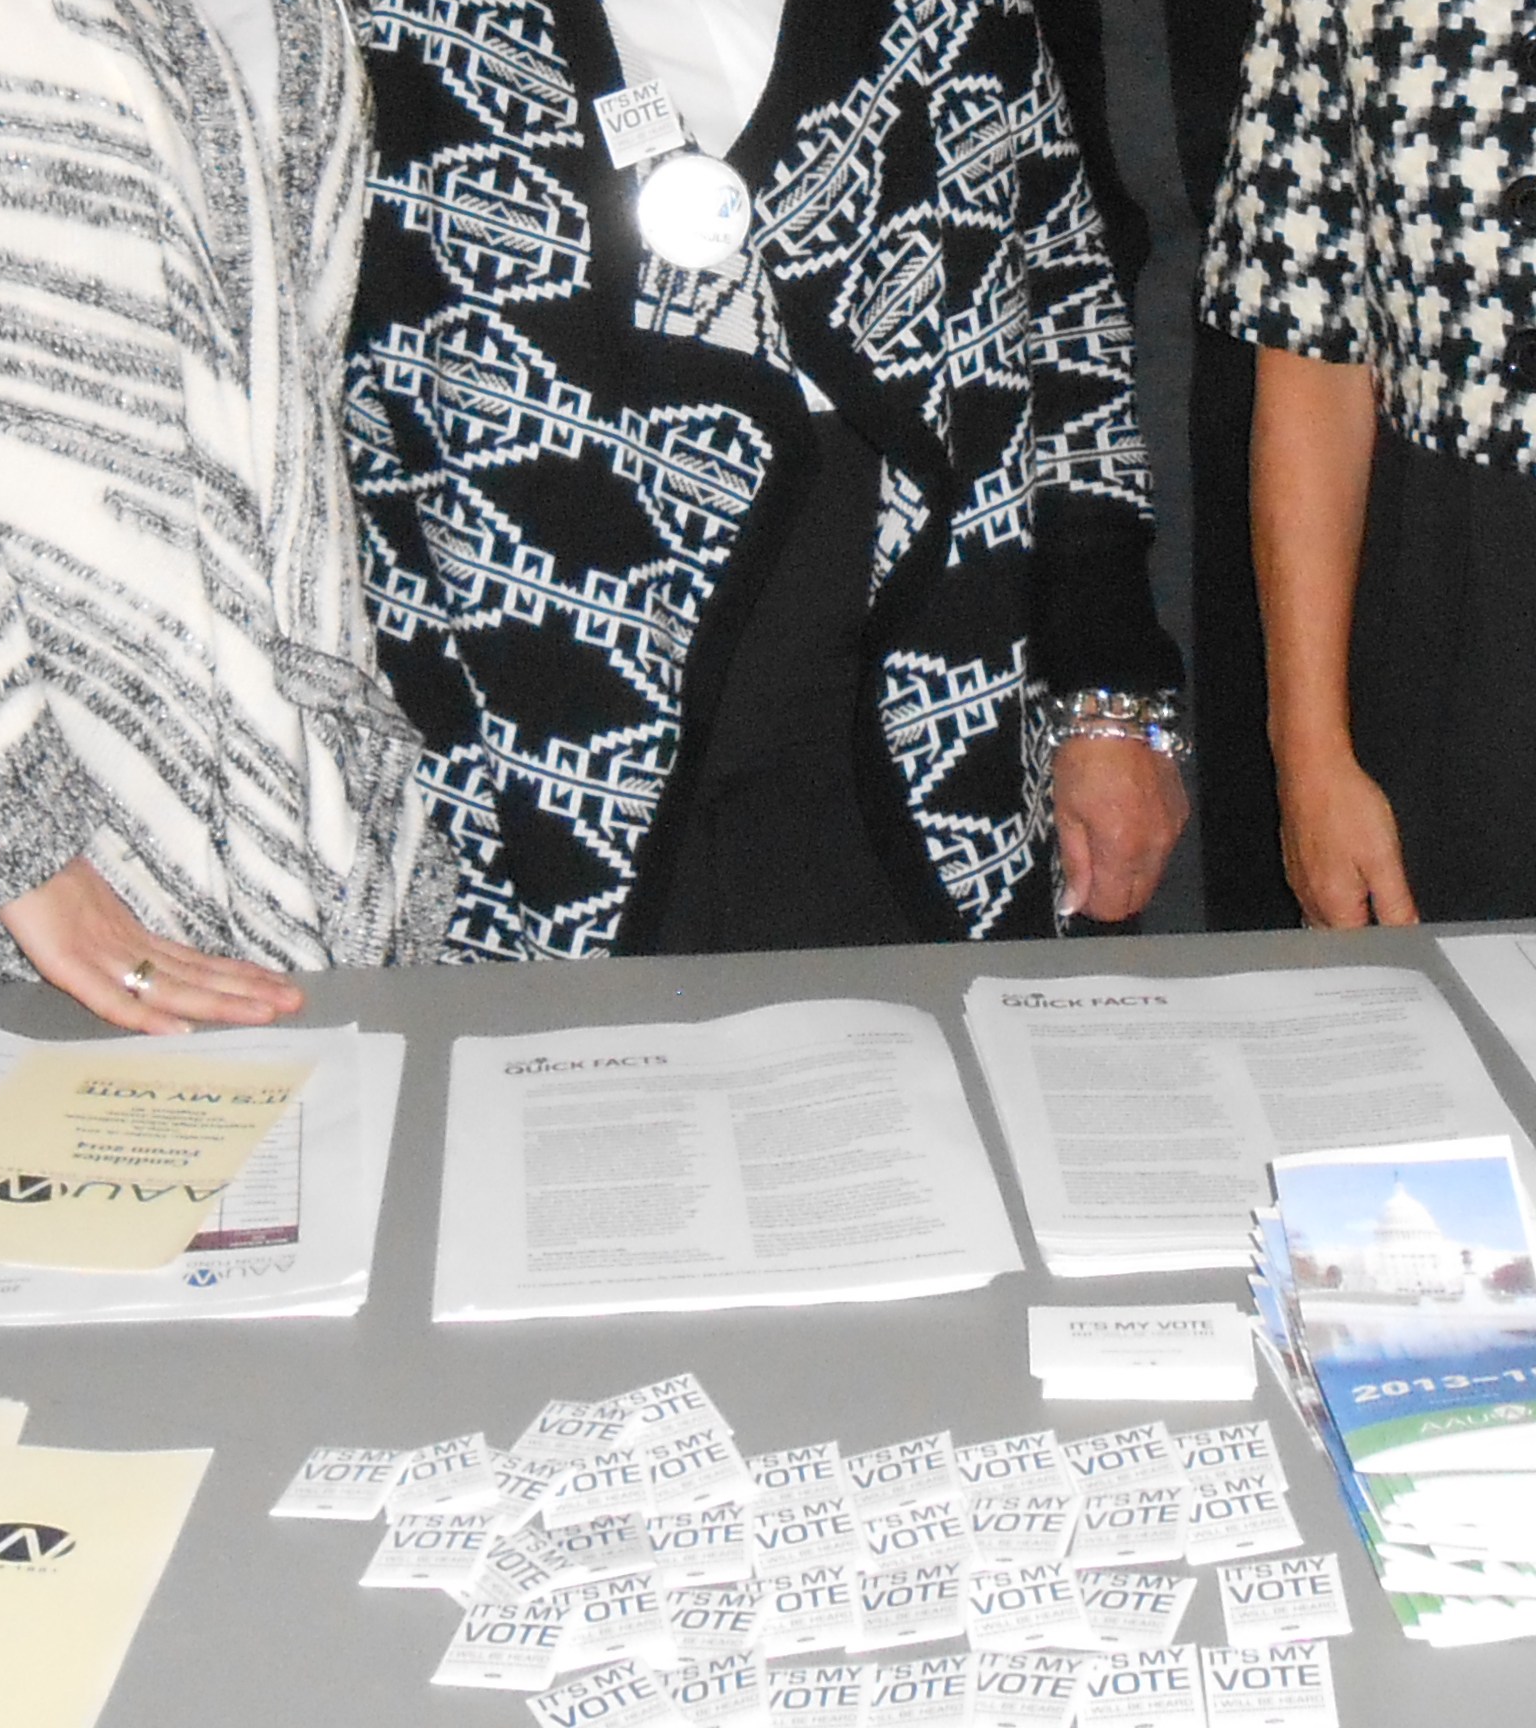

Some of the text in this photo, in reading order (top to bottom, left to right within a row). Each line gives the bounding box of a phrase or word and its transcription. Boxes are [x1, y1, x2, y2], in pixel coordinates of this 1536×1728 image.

[600, 81, 660, 115] IT'S MY
[607, 97, 669, 134] VOTE
[1001, 995, 1168, 1009] QUICK FACTS
[504, 1055, 668, 1075] QUICK FACTS
[75, 1085, 288, 1105] IT'S MY VOTE
[77, 1140, 200, 1157] Forum 2014
[72, 1152, 189, 1168] Candidates
[1070, 1320, 1215, 1331] IT'S MY VOTE
[546, 1402, 634, 1422] IT'S MY
[538, 1416, 624, 1442] VOTE
[1218, 1424, 1261, 1441] MY
[1004, 1434, 1047, 1453] MY
[1064, 1425, 1156, 1458] IT'S MY
[365, 1450, 401, 1463] MY
[847, 1436, 939, 1472] IT'S MY
[1070, 1439, 1168, 1476] VOTE
[304, 1462, 394, 1483] VOTE
[851, 1450, 946, 1490] VOTE
[958, 1449, 1057, 1483] VOTE
[803, 1497, 845, 1518] MY
[973, 1497, 1071, 1511] IT'S MY
[1084, 1487, 1182, 1510] IT'S MY
[398, 1514, 496, 1528] IT'S MY
[646, 1506, 745, 1531] IT'S MY
[909, 1501, 951, 1522] MY
[971, 1512, 1067, 1533] VOTE
[1083, 1503, 1181, 1531] VOTE
[393, 1530, 488, 1550] VOTE
[648, 1523, 745, 1552] VOTE
[755, 1513, 855, 1550] VOTE
[868, 1517, 965, 1555] VOTE
[486, 1538, 551, 1592] VOTE
[539, 1547, 575, 1571] MY
[1222, 1557, 1326, 1582] IT'S MY
[801, 1565, 845, 1586] MY
[861, 1562, 960, 1591] IT'S MY
[1019, 1562, 1063, 1582] MY
[1080, 1571, 1182, 1591] IT'S MY
[608, 1575, 653, 1596] MY
[862, 1578, 960, 1612] VOTE
[1228, 1574, 1334, 1605] VOTE
[665, 1591, 763, 1609] IT'S MY
[969, 1579, 1075, 1616] VOTE
[470, 1603, 572, 1622] IT'S MY
[465, 1621, 564, 1648] VOTE
[920, 1656, 968, 1676] MY
[978, 1652, 1083, 1674] IT'S MY
[1137, 1647, 1186, 1666] MY
[1209, 1644, 1316, 1666] IT'S MY
[816, 1666, 863, 1683] MY
[976, 1672, 1077, 1699] VOTE
[1086, 1666, 1191, 1698] VOTE
[1212, 1664, 1322, 1691] VOTE
[536, 1660, 638, 1712] IT'S MY
[549, 1676, 658, 1728] VOTE
